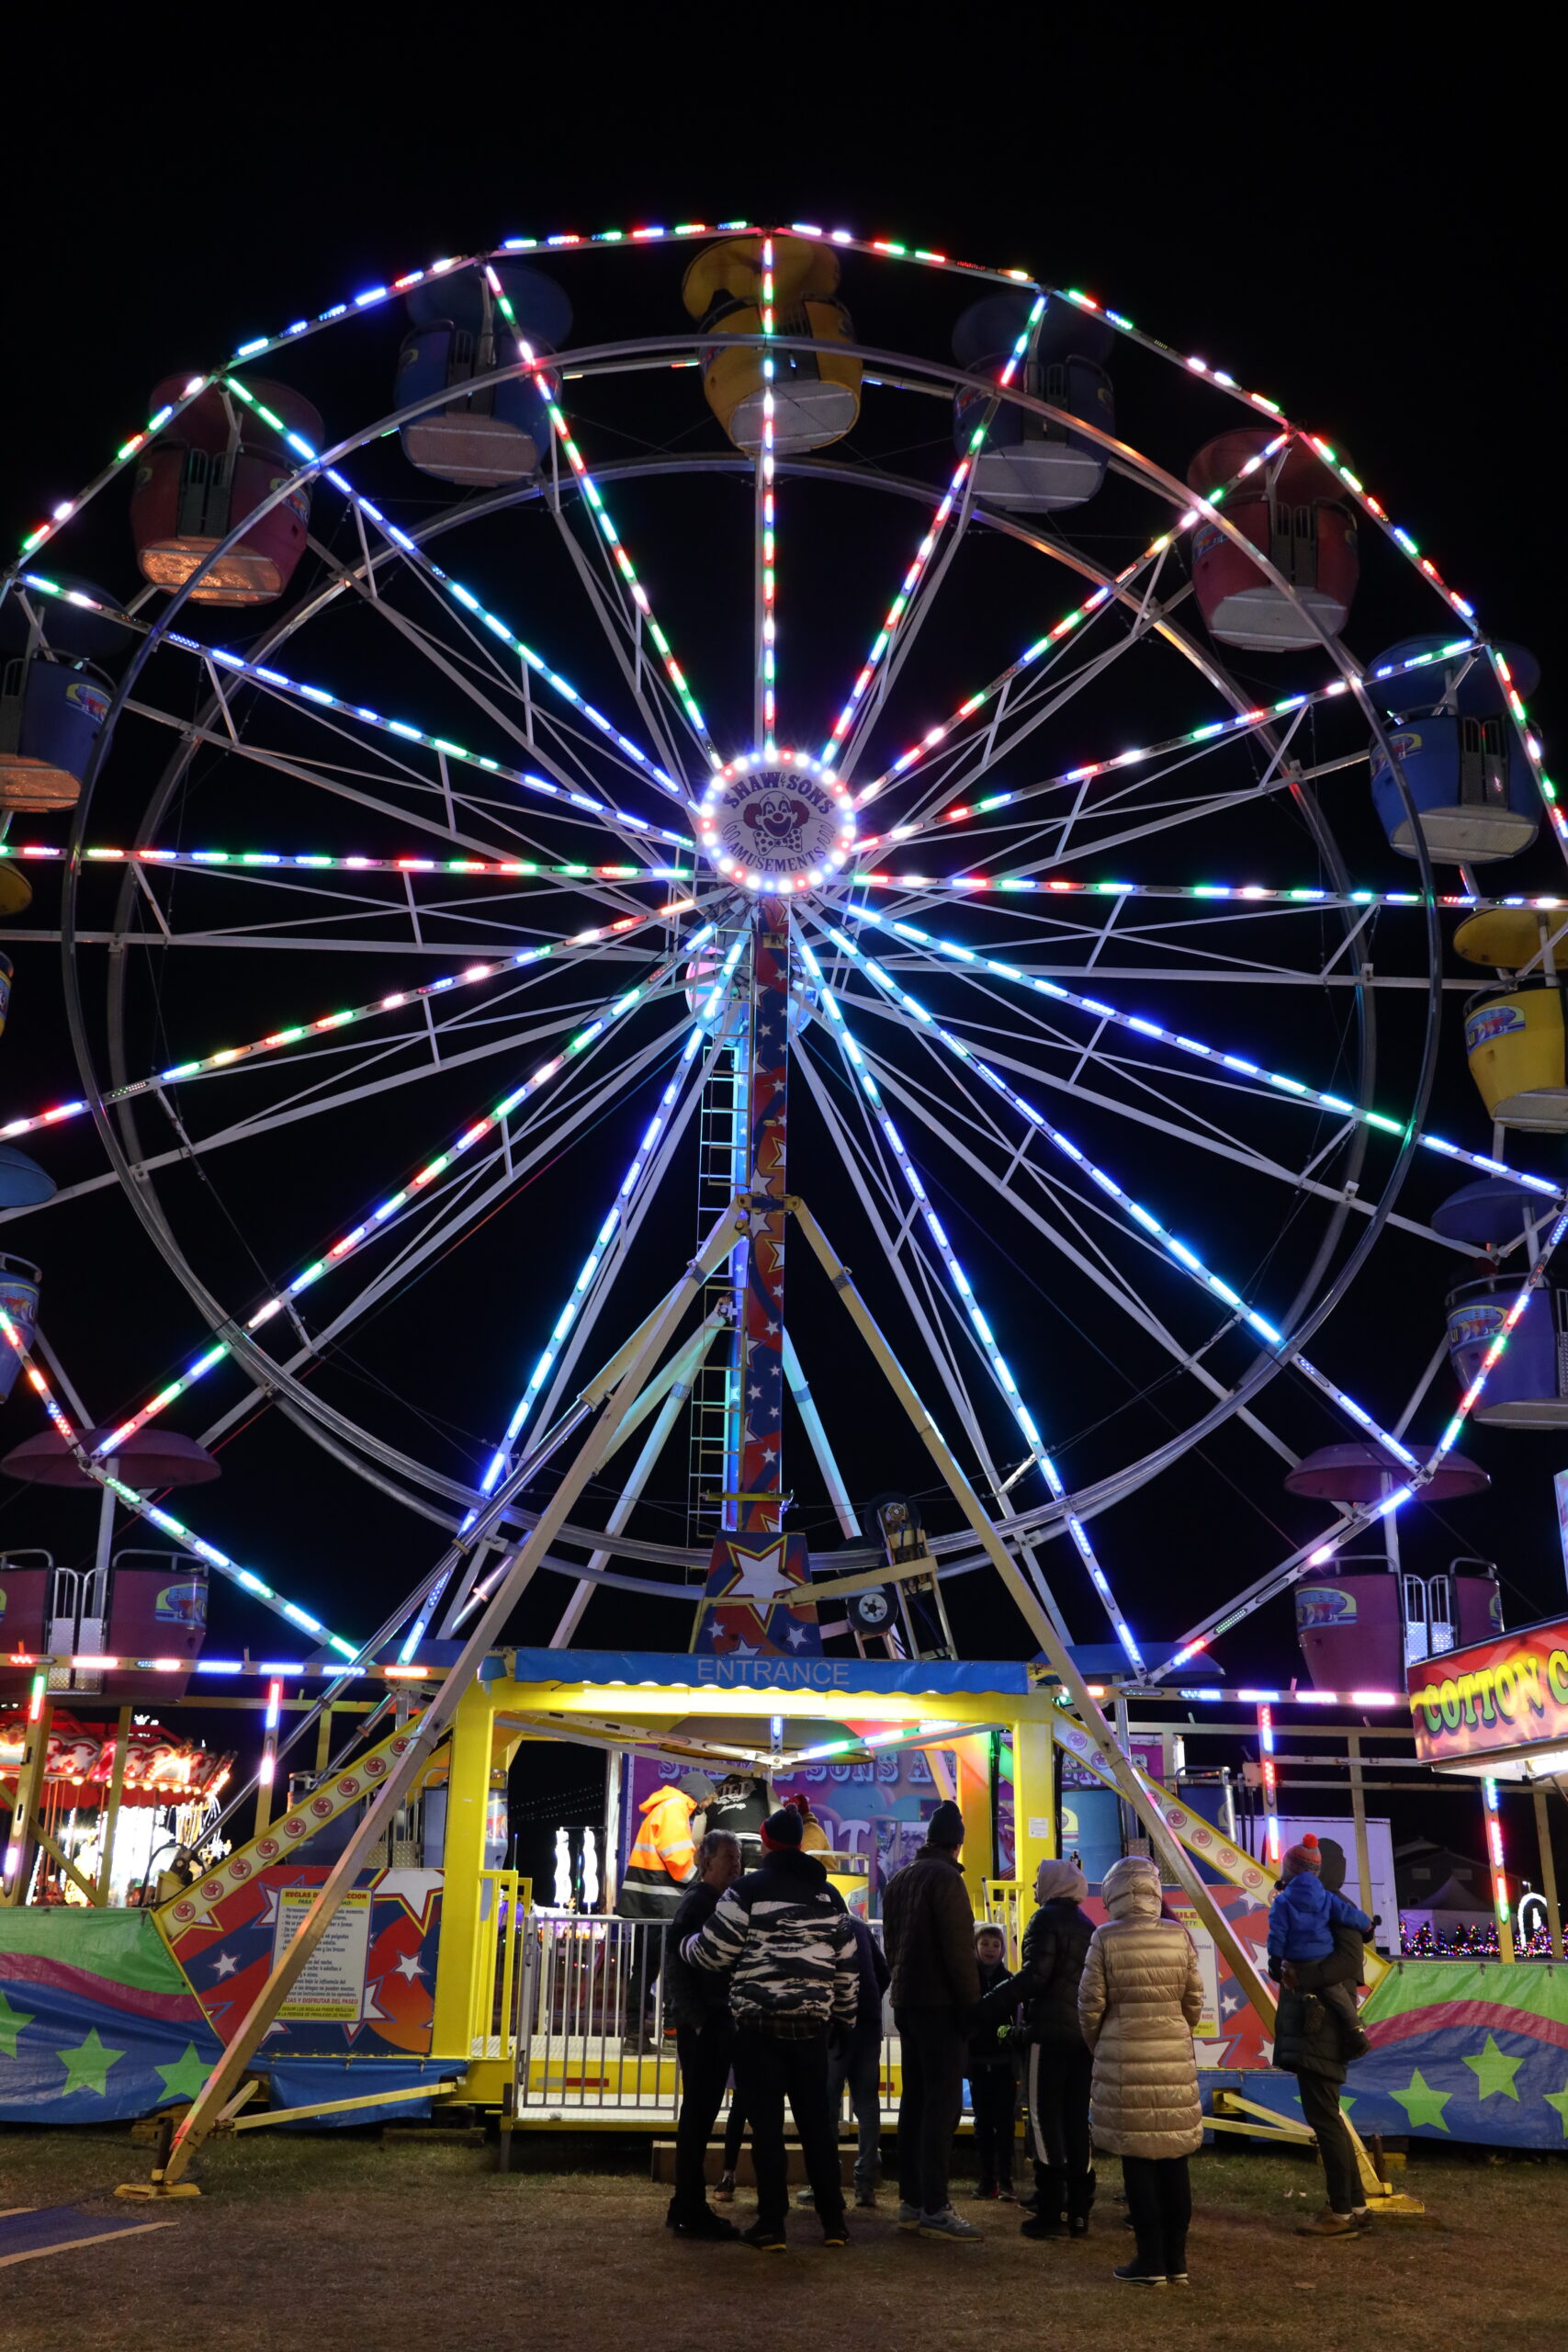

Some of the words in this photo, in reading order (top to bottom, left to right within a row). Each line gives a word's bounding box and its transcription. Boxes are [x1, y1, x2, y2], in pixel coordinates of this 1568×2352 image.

[723, 772, 781, 809] SHAW
[786, 774, 836, 815] SONS
[728, 842, 826, 873] AMUSEMENTS
[696, 1658, 850, 1686] ENTRANCE
[1423, 1657, 1543, 1733] COTTON
